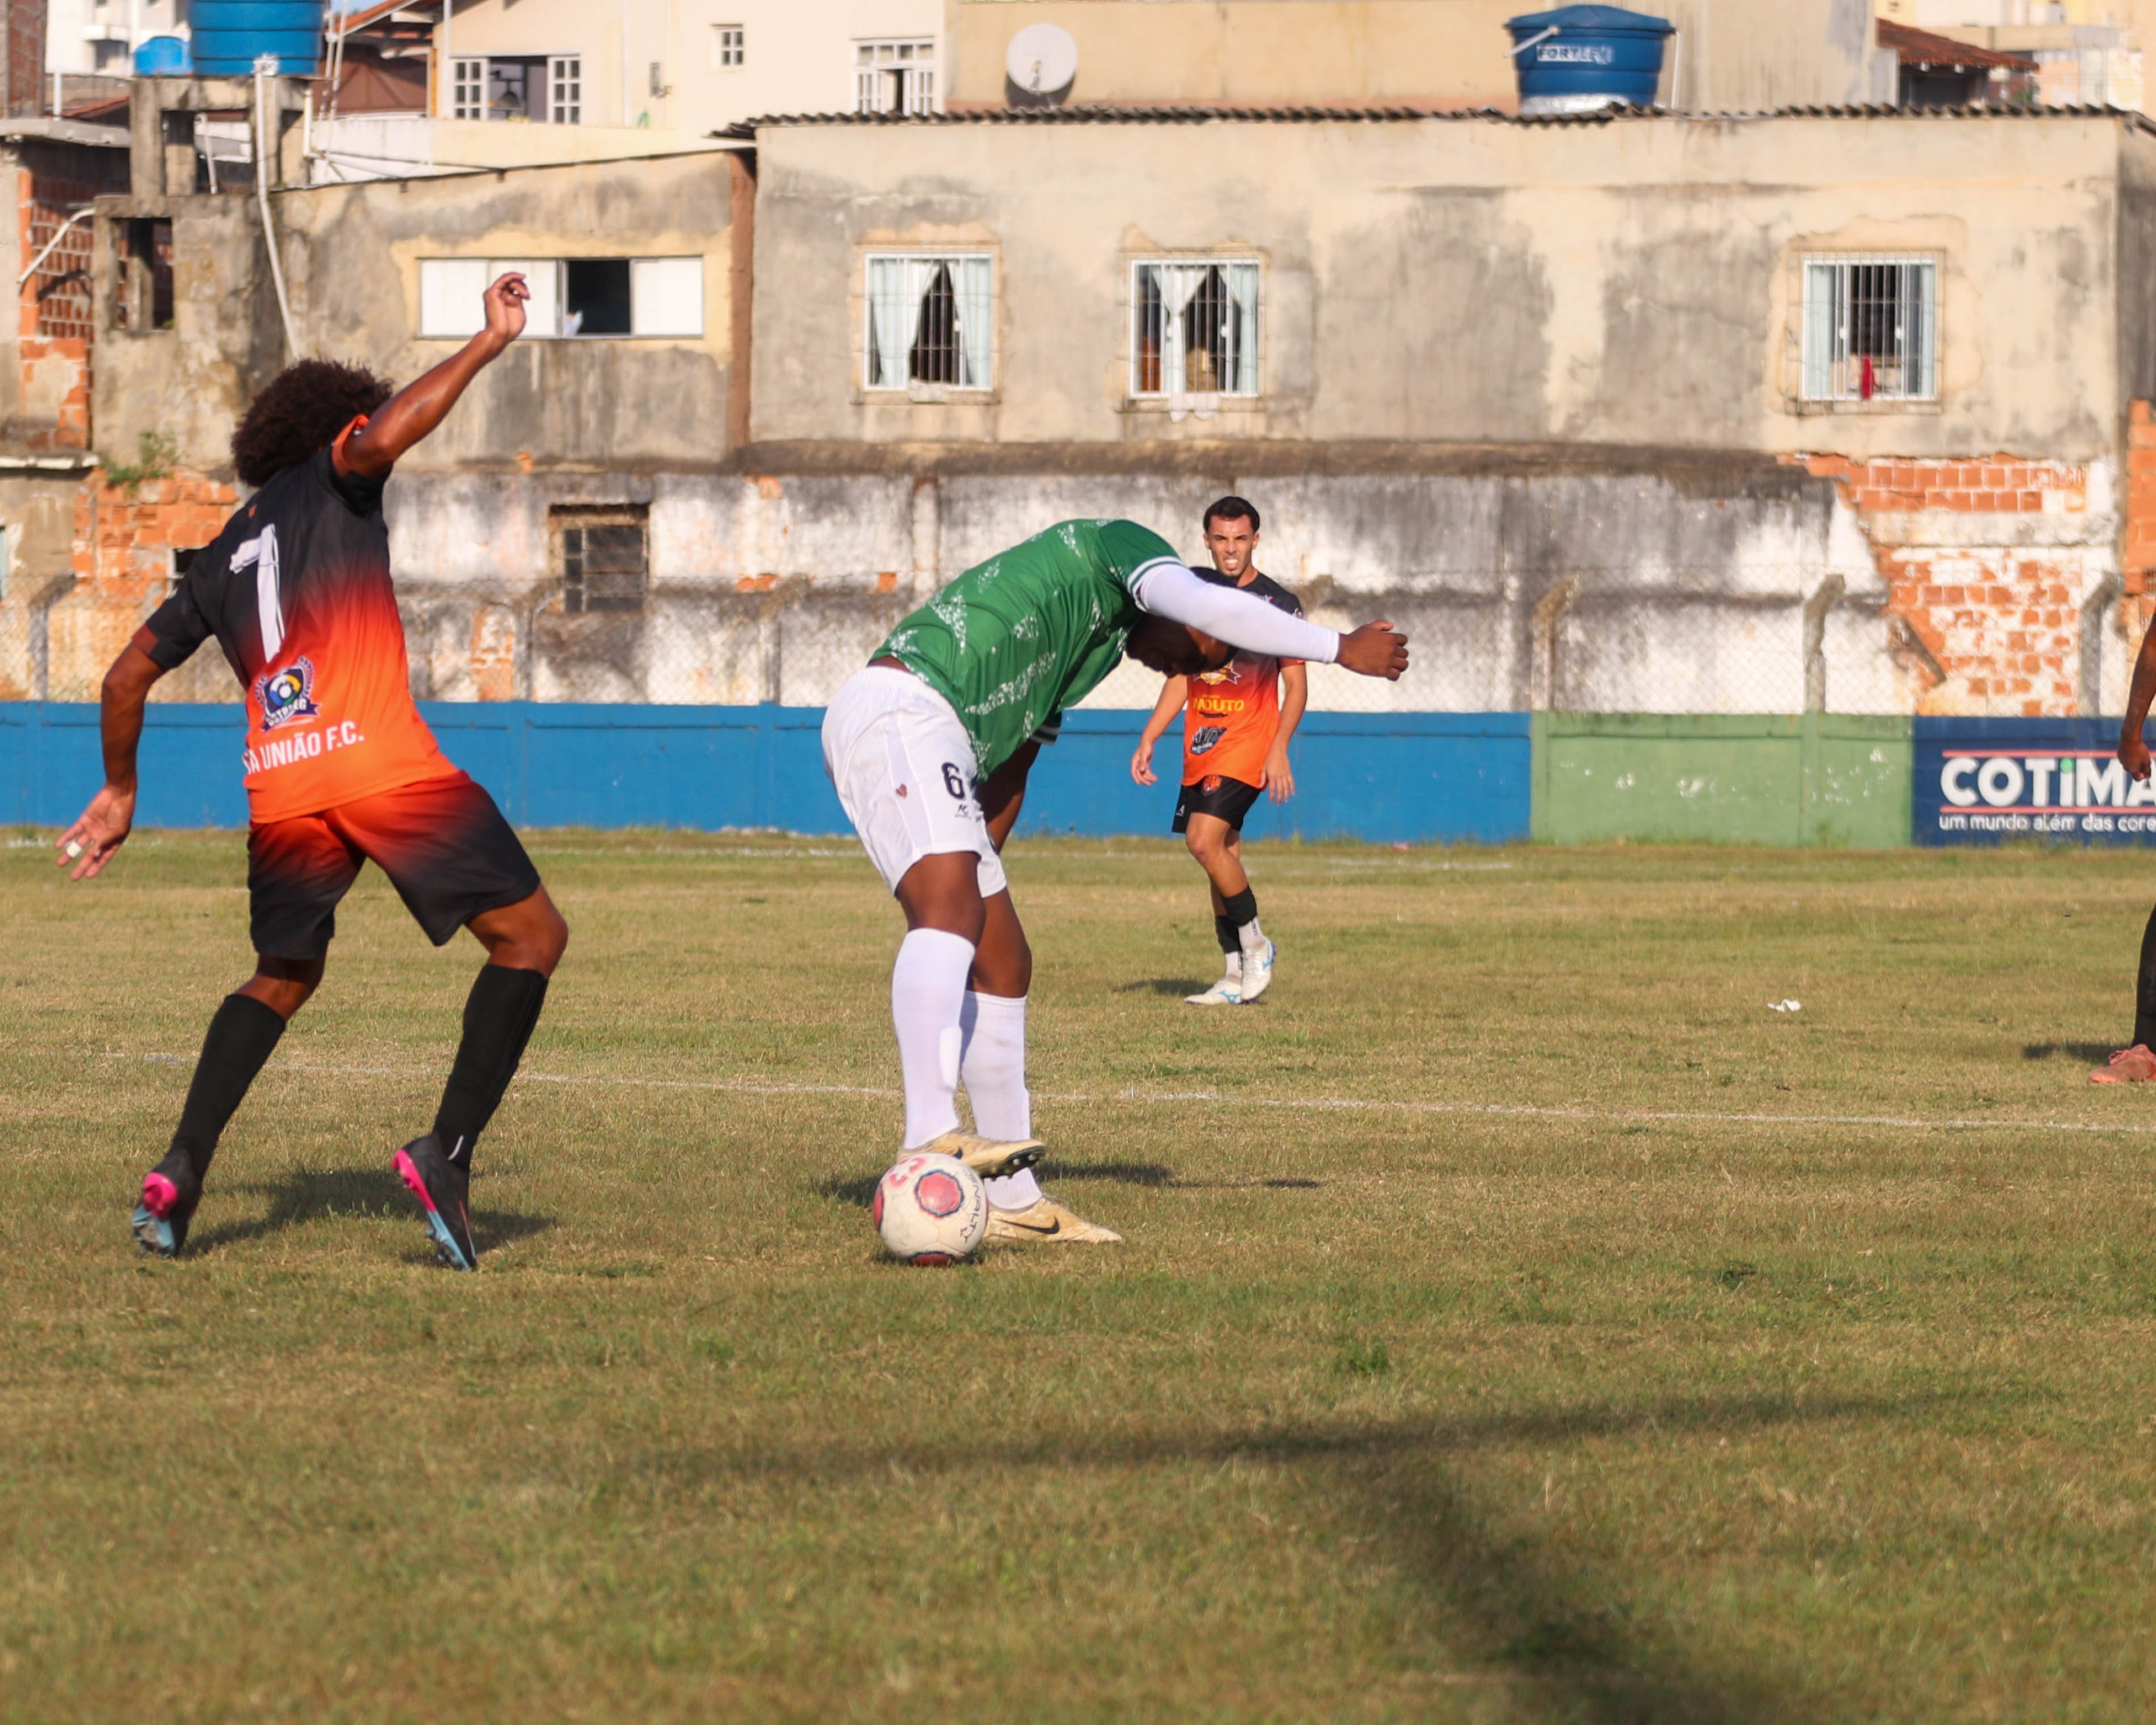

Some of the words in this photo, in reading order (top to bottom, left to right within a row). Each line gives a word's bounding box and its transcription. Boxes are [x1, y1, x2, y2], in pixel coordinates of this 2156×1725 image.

[259, 732, 321, 770] UNIÃO
[326, 721, 364, 751] F.C.
[941, 761, 965, 800] 6
[1940, 815, 1967, 830] um
[1971, 813, 2029, 830] mundo
[2033, 813, 2074, 830] além
[2082, 813, 2112, 830] das
